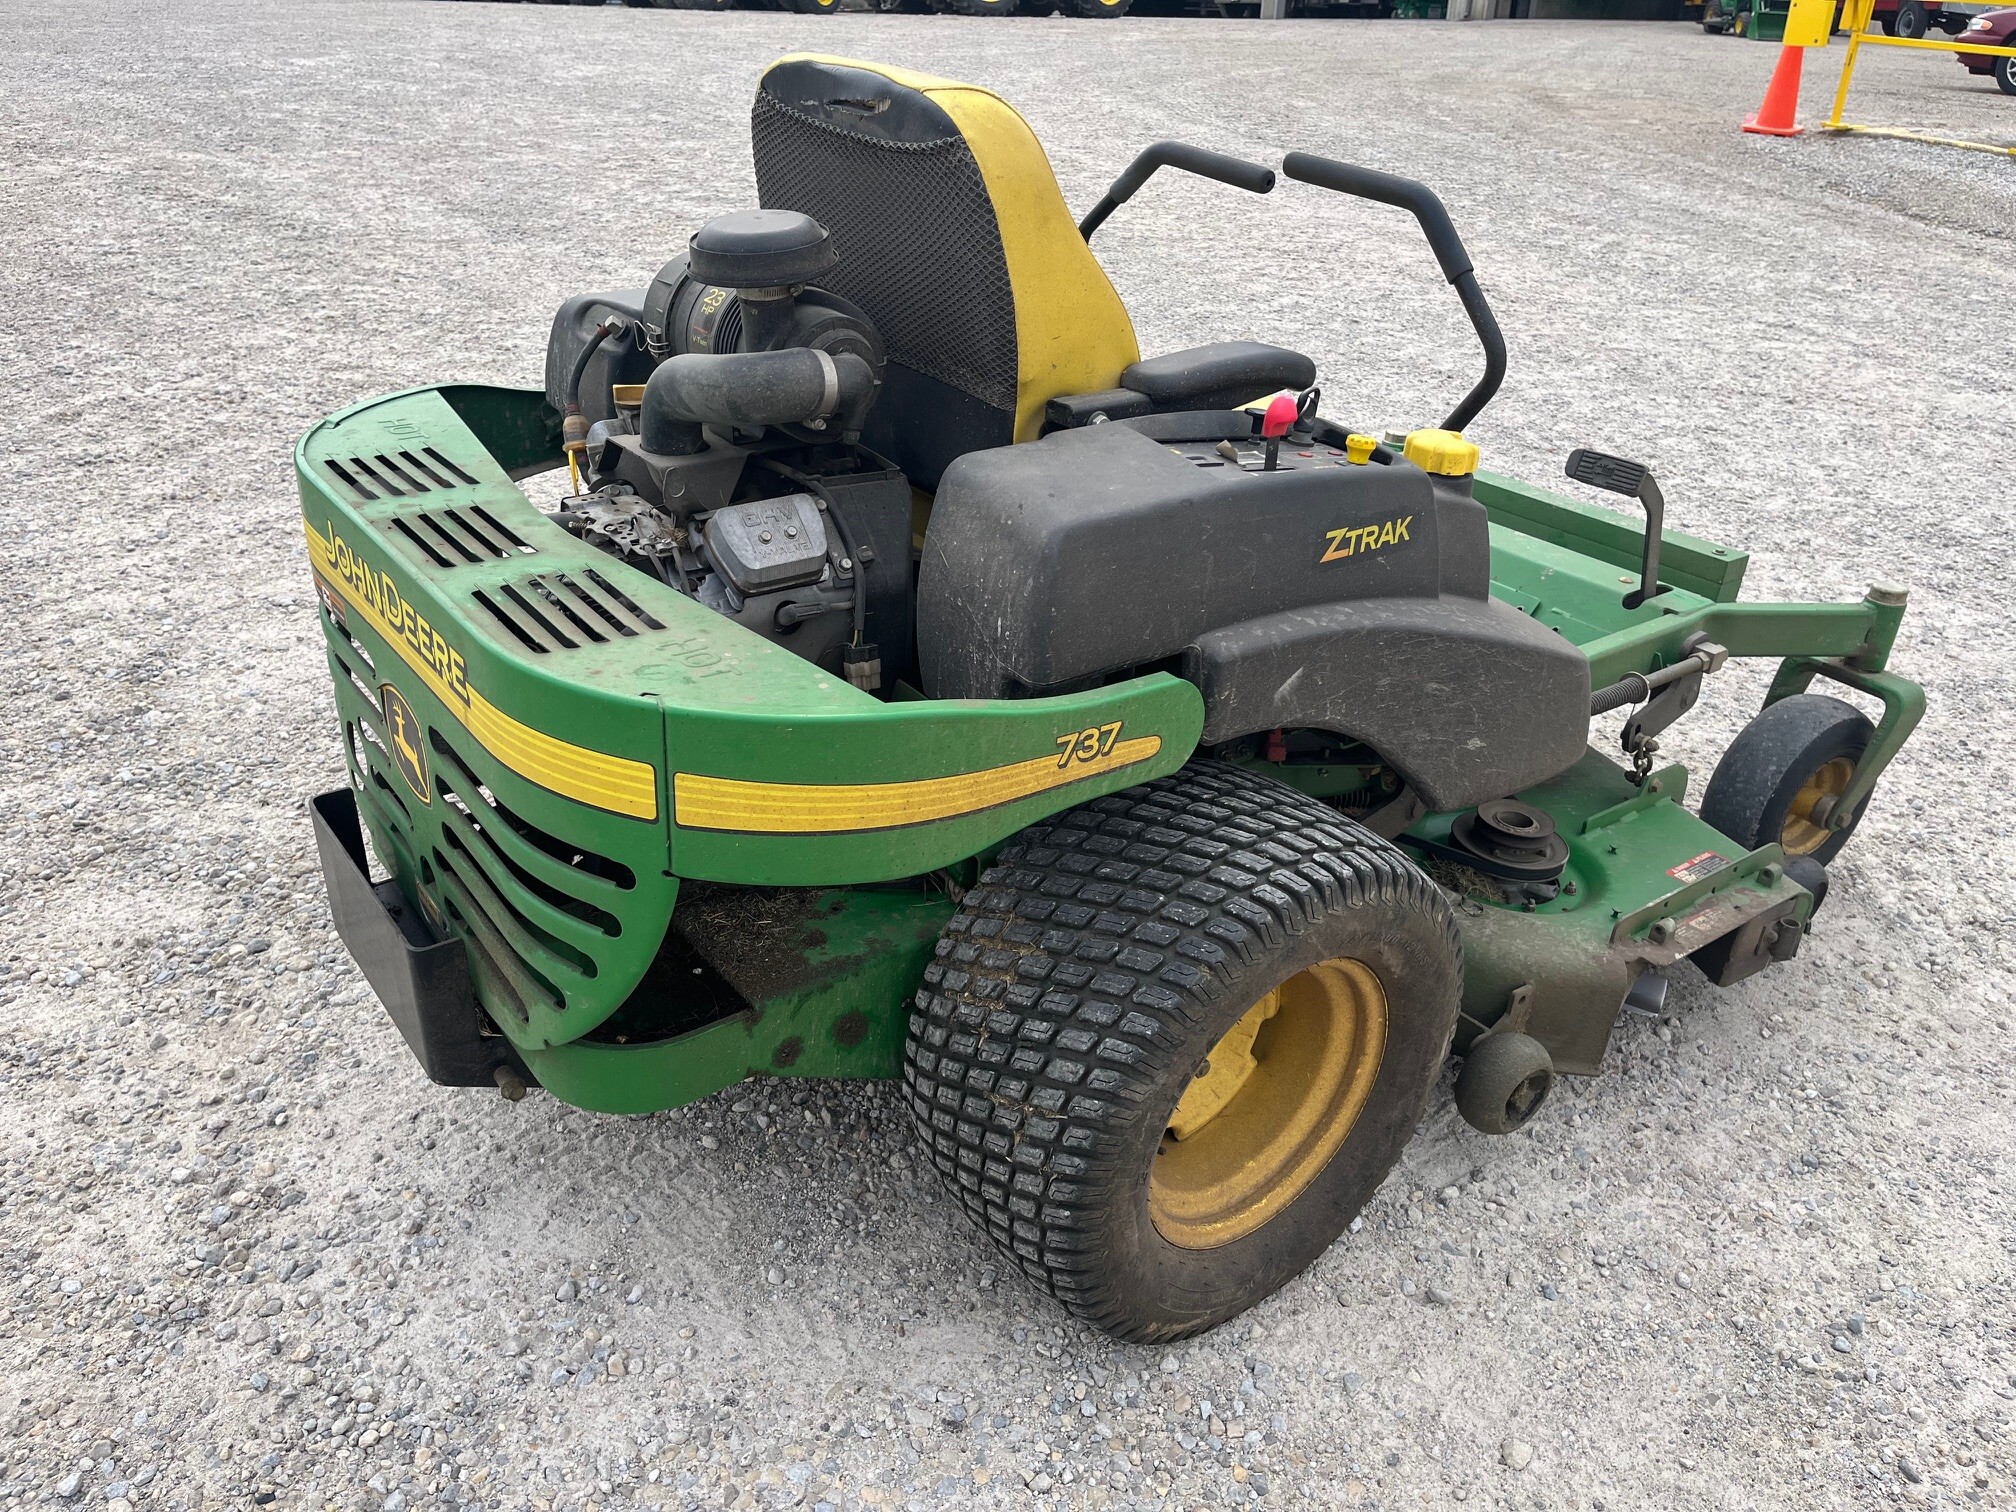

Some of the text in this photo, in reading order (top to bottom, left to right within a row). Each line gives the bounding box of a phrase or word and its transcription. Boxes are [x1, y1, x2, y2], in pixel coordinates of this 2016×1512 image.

[701, 303, 715, 315] HP
[703, 288, 726, 306] 23
[377, 418, 431, 441] HOT
[742, 506, 793, 528] OHV
[1319, 515, 1414, 564] ZTRAK
[325, 519, 471, 708] JOHN DEERE
[656, 638, 742, 678] HOT
[1056, 720, 1124, 769] 737
